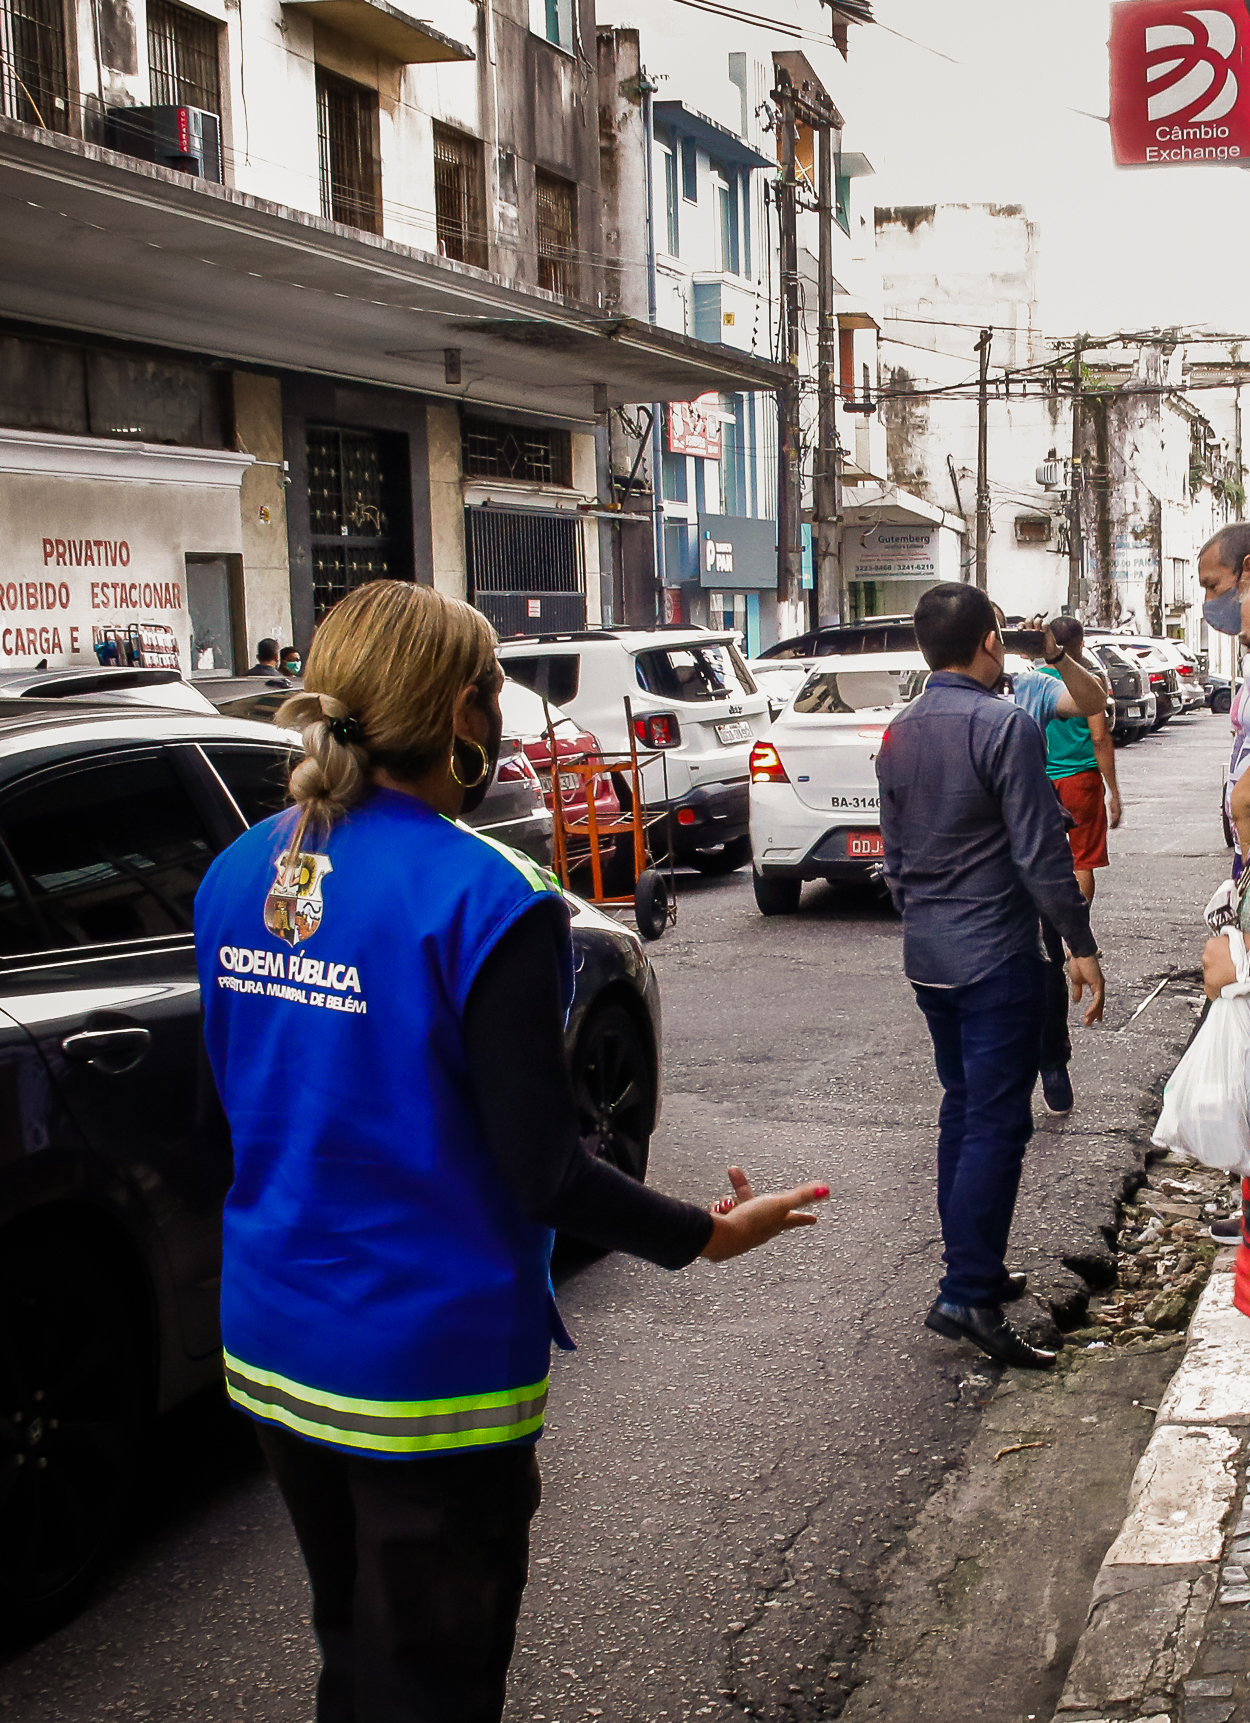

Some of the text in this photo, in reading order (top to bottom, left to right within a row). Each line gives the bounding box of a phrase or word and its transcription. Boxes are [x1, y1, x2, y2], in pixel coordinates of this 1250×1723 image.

[1155, 124, 1229, 141] Câmbio
[1145, 145, 1241, 162] Exchange
[878, 534, 930, 544] Gutemberg
[42, 538, 131, 567] PRIVATIVO
[90, 582, 182, 609] ESTACIONAR
[2, 627, 64, 656] CARGA
[70, 626, 81, 653] E
[218, 945, 362, 993] ORDEM PÚBLICA
[310, 991, 325, 1007] DE
[325, 995, 367, 1015] BELÉM
